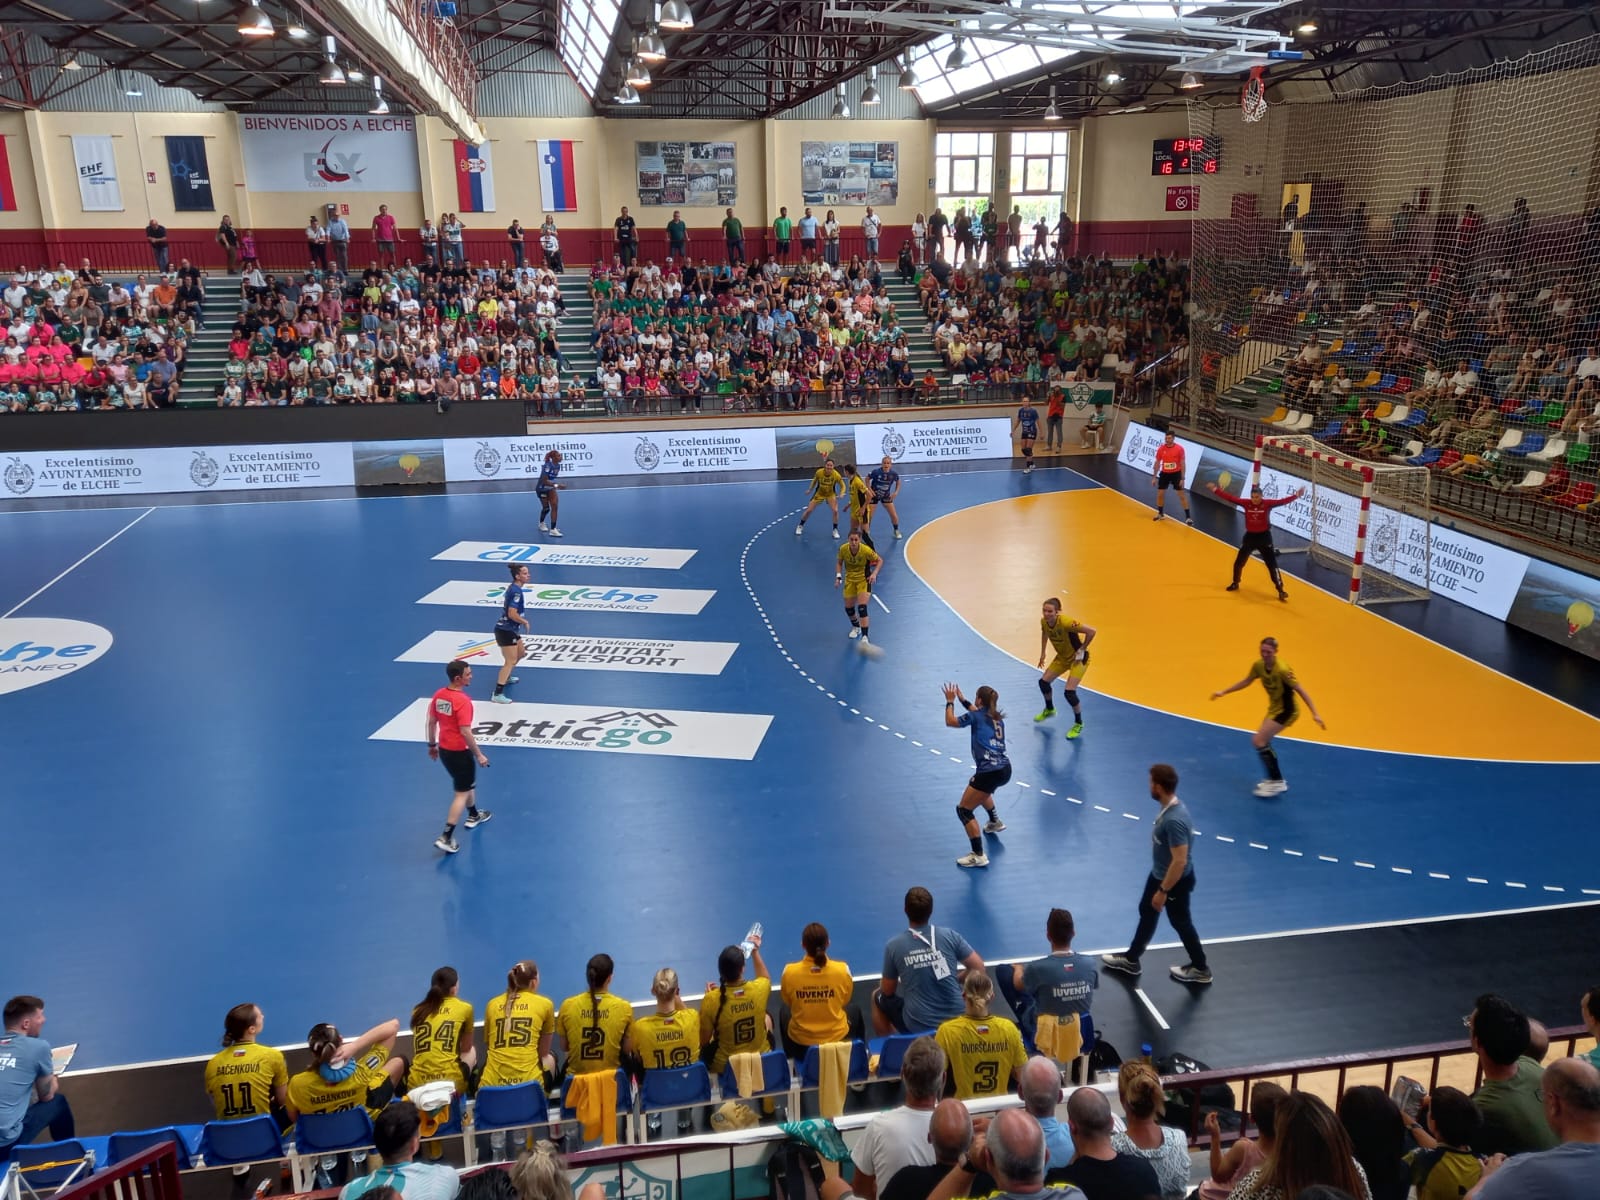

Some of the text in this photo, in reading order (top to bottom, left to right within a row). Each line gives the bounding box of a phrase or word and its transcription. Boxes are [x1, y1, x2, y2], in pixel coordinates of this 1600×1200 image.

[244, 117, 412, 132] BIENVENIDOS A ELCHE
[1174, 139, 1203, 151] 13:42
[80, 162, 103, 175] EHF
[1162, 162, 1172, 174] 16
[1182, 158, 1188, 167] 2
[1205, 161, 1217, 172] 15
[908, 436, 987, 447] AYUNTAMIENTO
[504, 451, 593, 463] AYUNTIENTO
[663, 446, 747, 457] AYUNTAMIENTO
[926, 447, 971, 457] de ELCHE
[223, 461, 320, 473] AYUNTAMIENTO
[682, 457, 730, 467] de ELCHE
[39, 467, 142, 480] AYUNTAMIENTO
[525, 464, 537, 473] de
[245, 473, 300, 484] de ELCHE
[62, 480, 120, 490] de ELCHE
[1286, 513, 1296, 525] de
[561, 559, 644, 567] ALICANTE
[1409, 562, 1423, 577] de
[536, 587, 660, 603] elche
[597, 639, 675, 648] Valenciana
[551, 653, 685, 668] L'ESPORT
[1053, 984, 1090, 998] IUVENTA
[495, 1017, 532, 1049] 15
[733, 1015, 755, 1046] 6
[416, 1020, 454, 1054] 24
[581, 1027, 605, 1060] 2
[653, 1046, 692, 1069] 18
[973, 1061, 999, 1094] 3
[222, 1082, 256, 1116] 11
